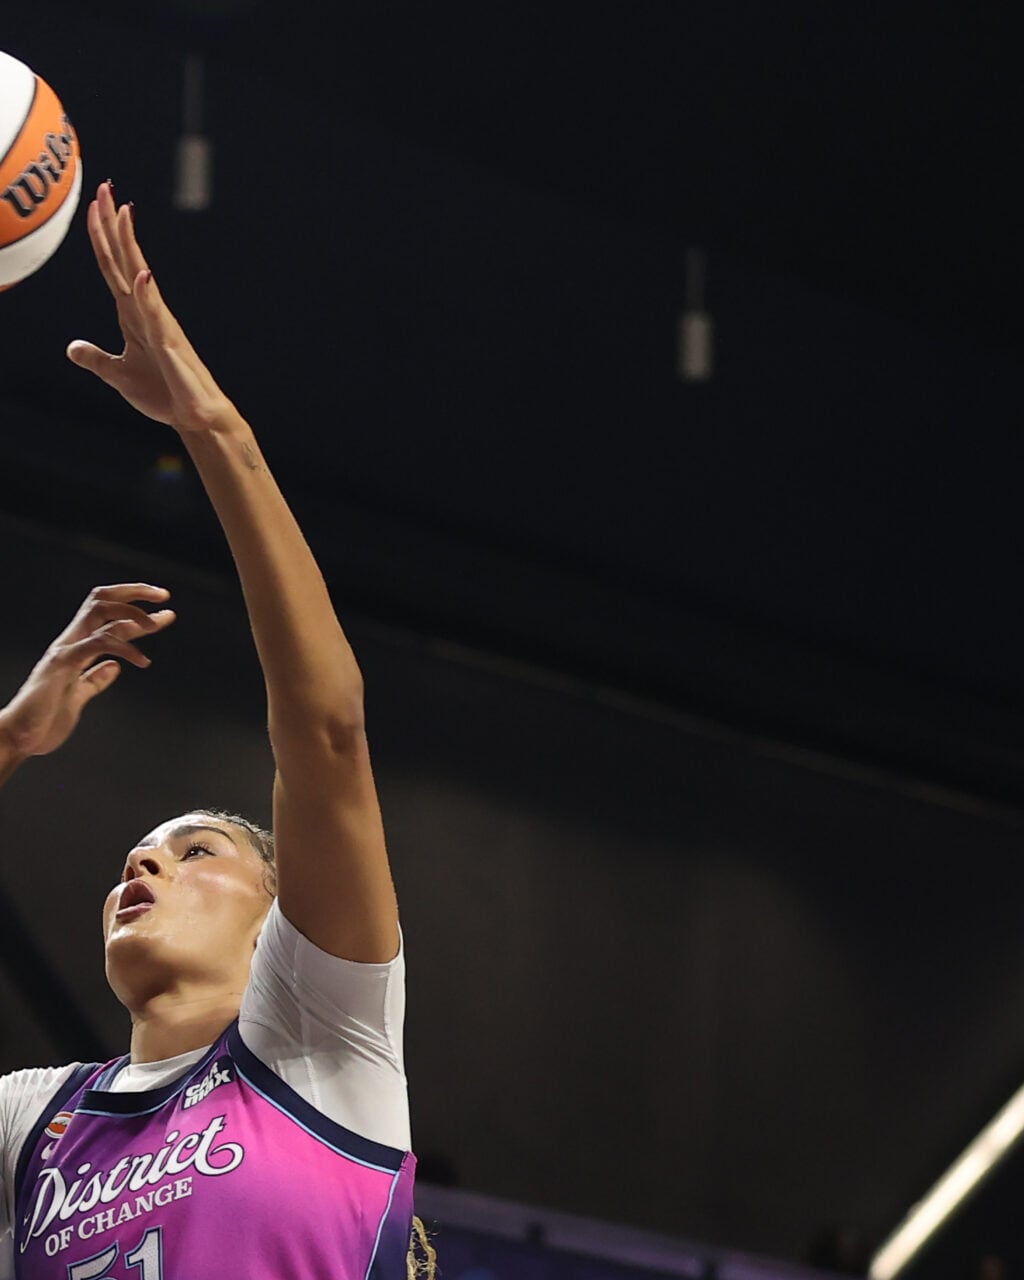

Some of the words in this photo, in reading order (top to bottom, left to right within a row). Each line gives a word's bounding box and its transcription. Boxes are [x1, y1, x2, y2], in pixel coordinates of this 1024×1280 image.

[21, 1114, 245, 1254] District
[45, 1225, 74, 1257] OF
[78, 1176, 194, 1240] CHANGE
